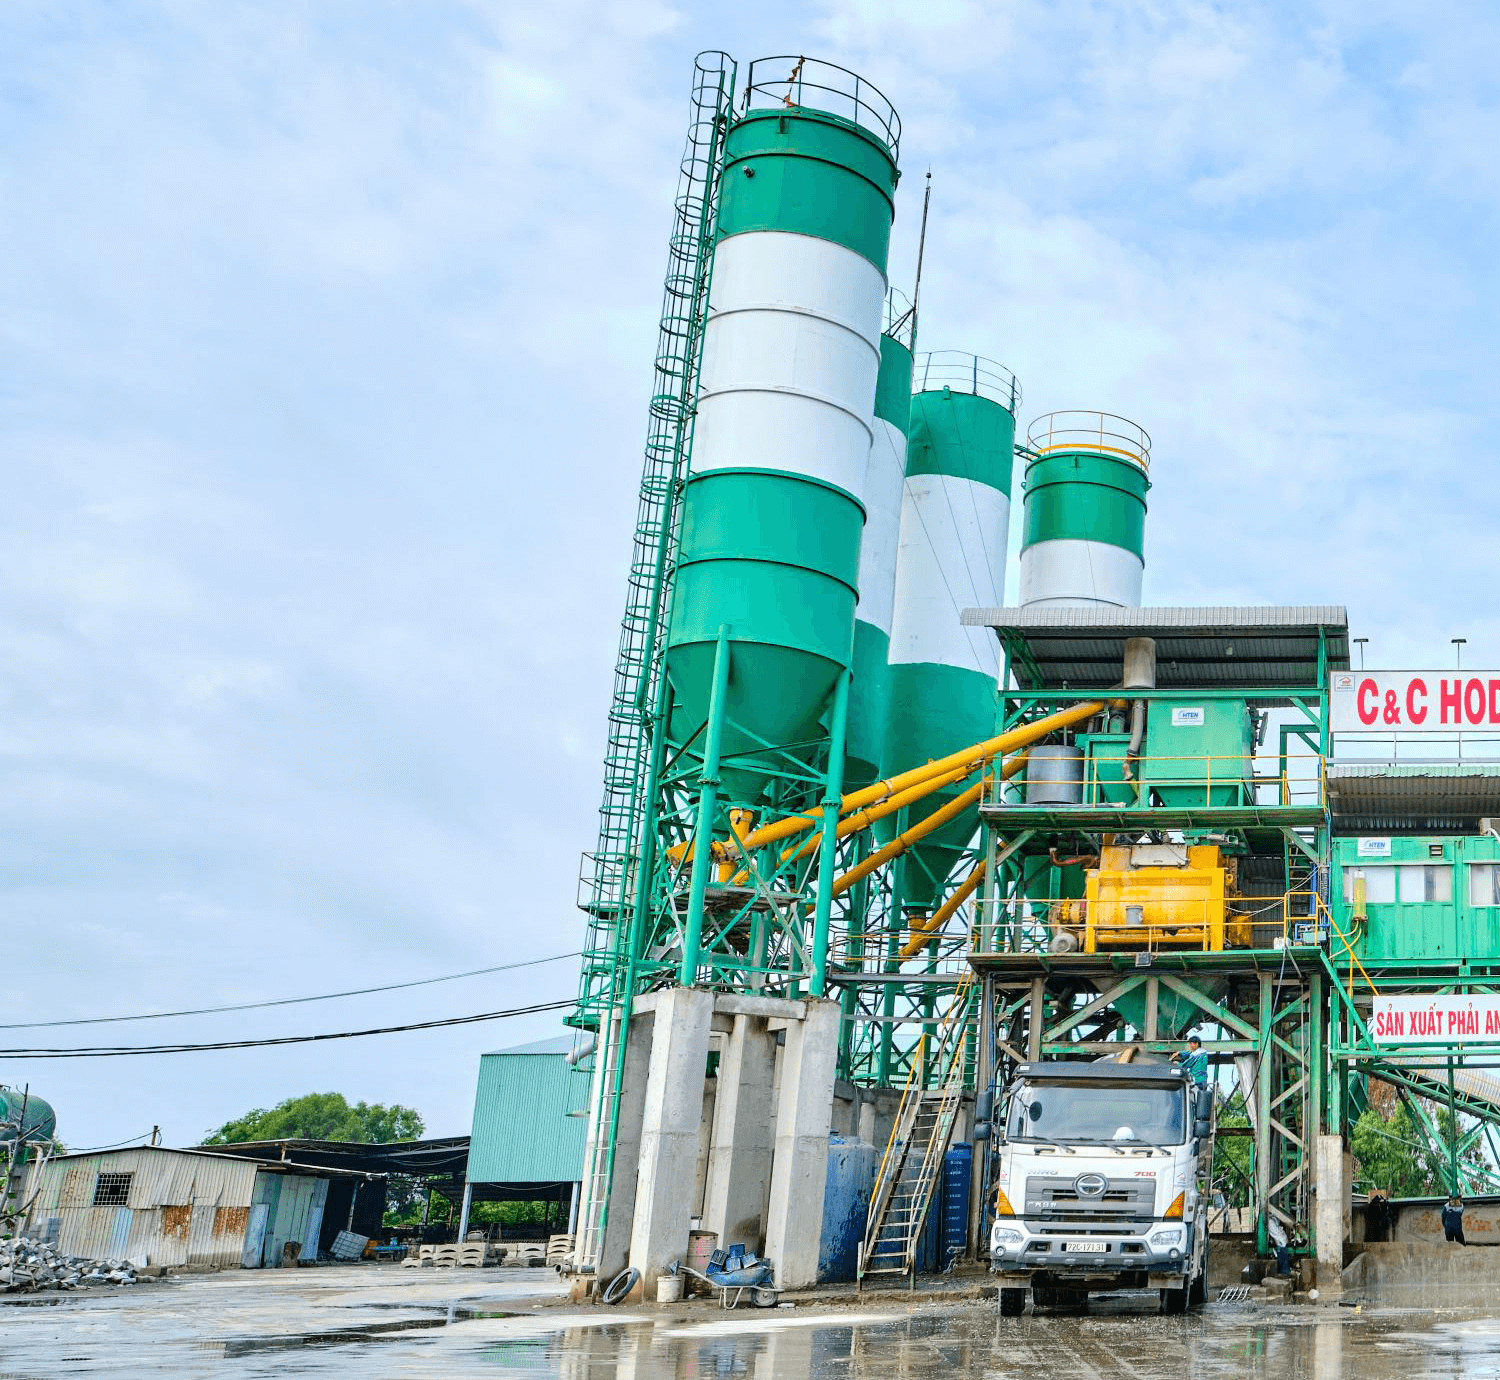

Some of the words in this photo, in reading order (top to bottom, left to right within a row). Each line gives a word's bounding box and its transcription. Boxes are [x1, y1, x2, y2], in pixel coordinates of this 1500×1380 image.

[1376, 1003, 1404, 1036] SẢN
[1409, 1003, 1443, 1035] XUẤT
[1448, 1002, 1479, 1035] PHẢI
